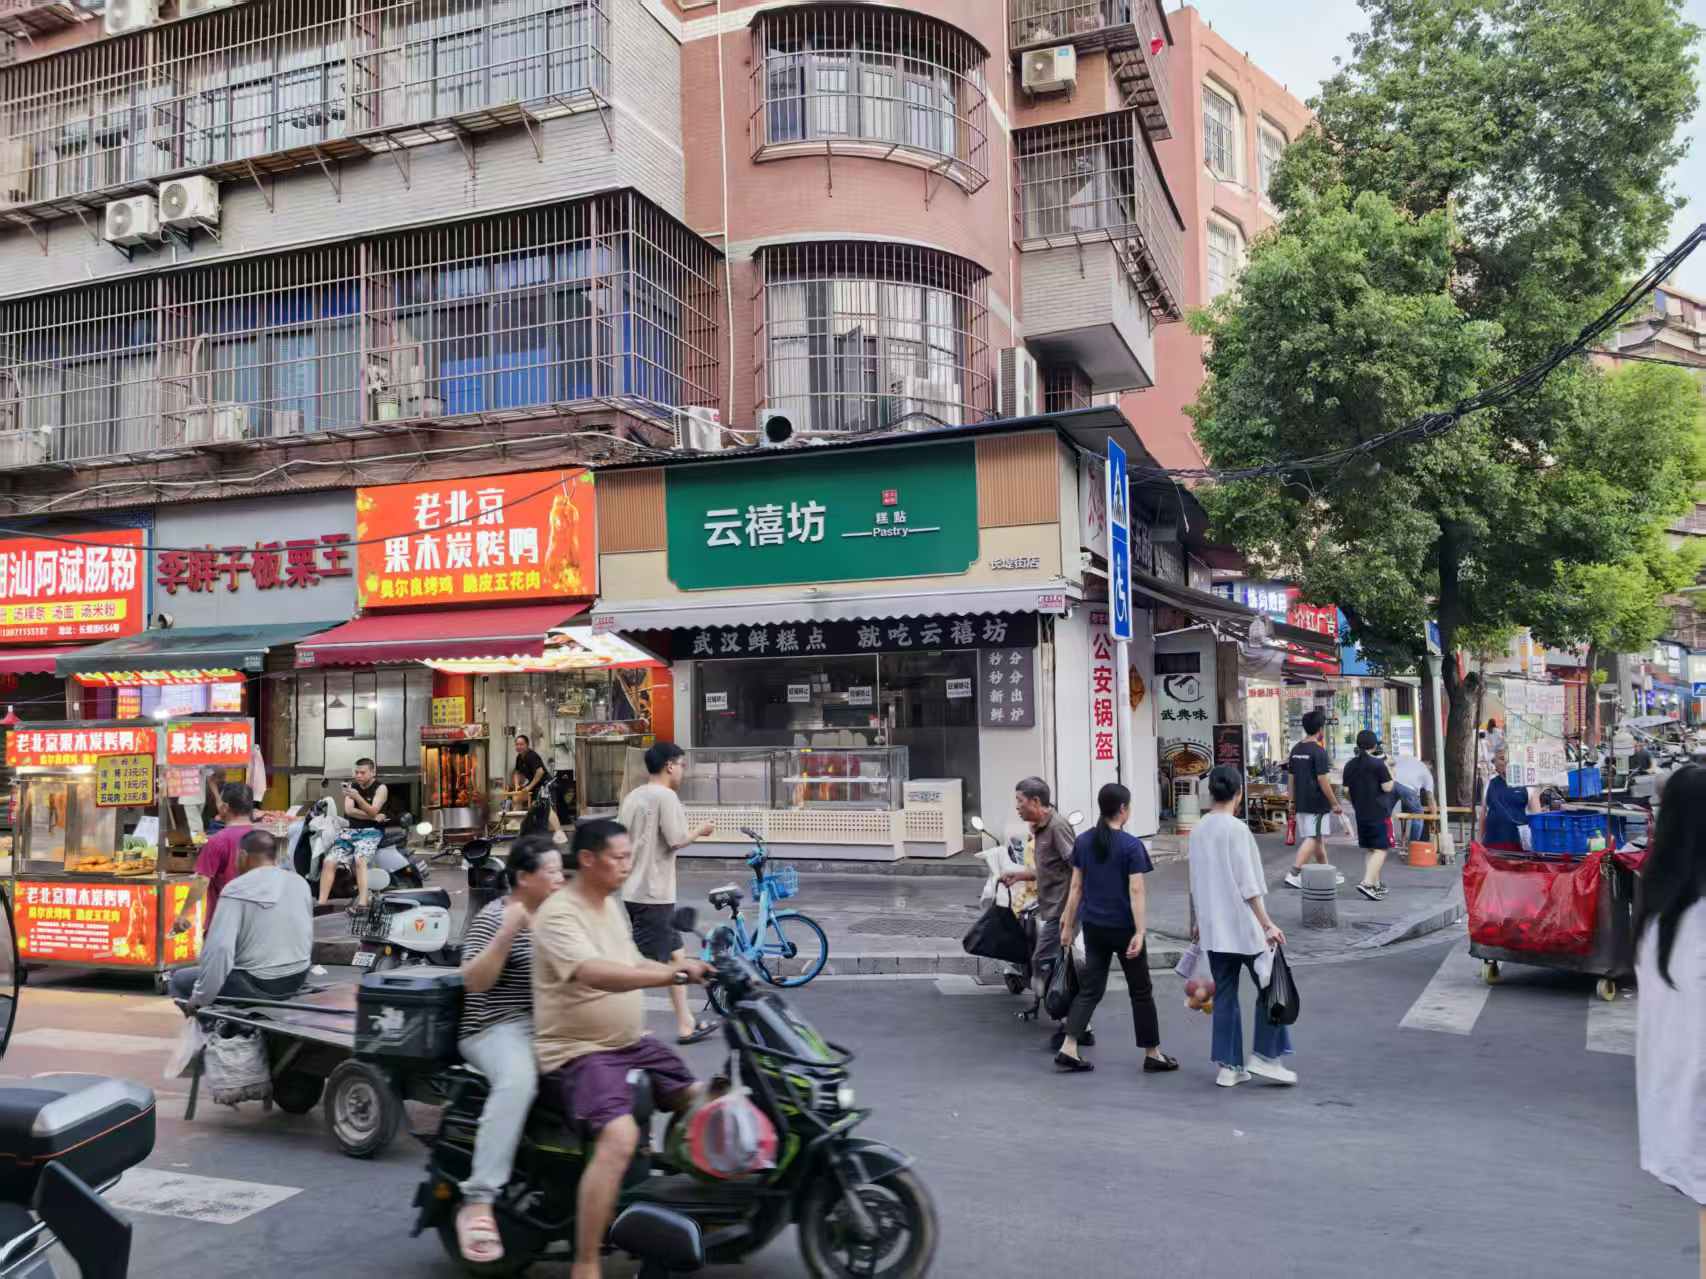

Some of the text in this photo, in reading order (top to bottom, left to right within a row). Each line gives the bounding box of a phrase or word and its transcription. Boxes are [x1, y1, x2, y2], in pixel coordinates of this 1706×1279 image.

[414, 488, 504, 530] 老北京
[703, 500, 826, 547] 云禧坊
[384, 527, 539, 573] 果木炭烤鸭
[873, 526, 909, 538] Pastry
[157, 533, 353, 595] 李胖子板栗王
[380, 570, 541, 599] 奥尔良烤鸡 脆皮五花肉
[692, 617, 1009, 656] 武汉鲜糕点 就吃云禧坊
[1008, 650, 1026, 722] 分分出炉
[1093, 633, 1114, 761] 公安锅盔
[171, 731, 248, 754] 果木炭烤鸭
